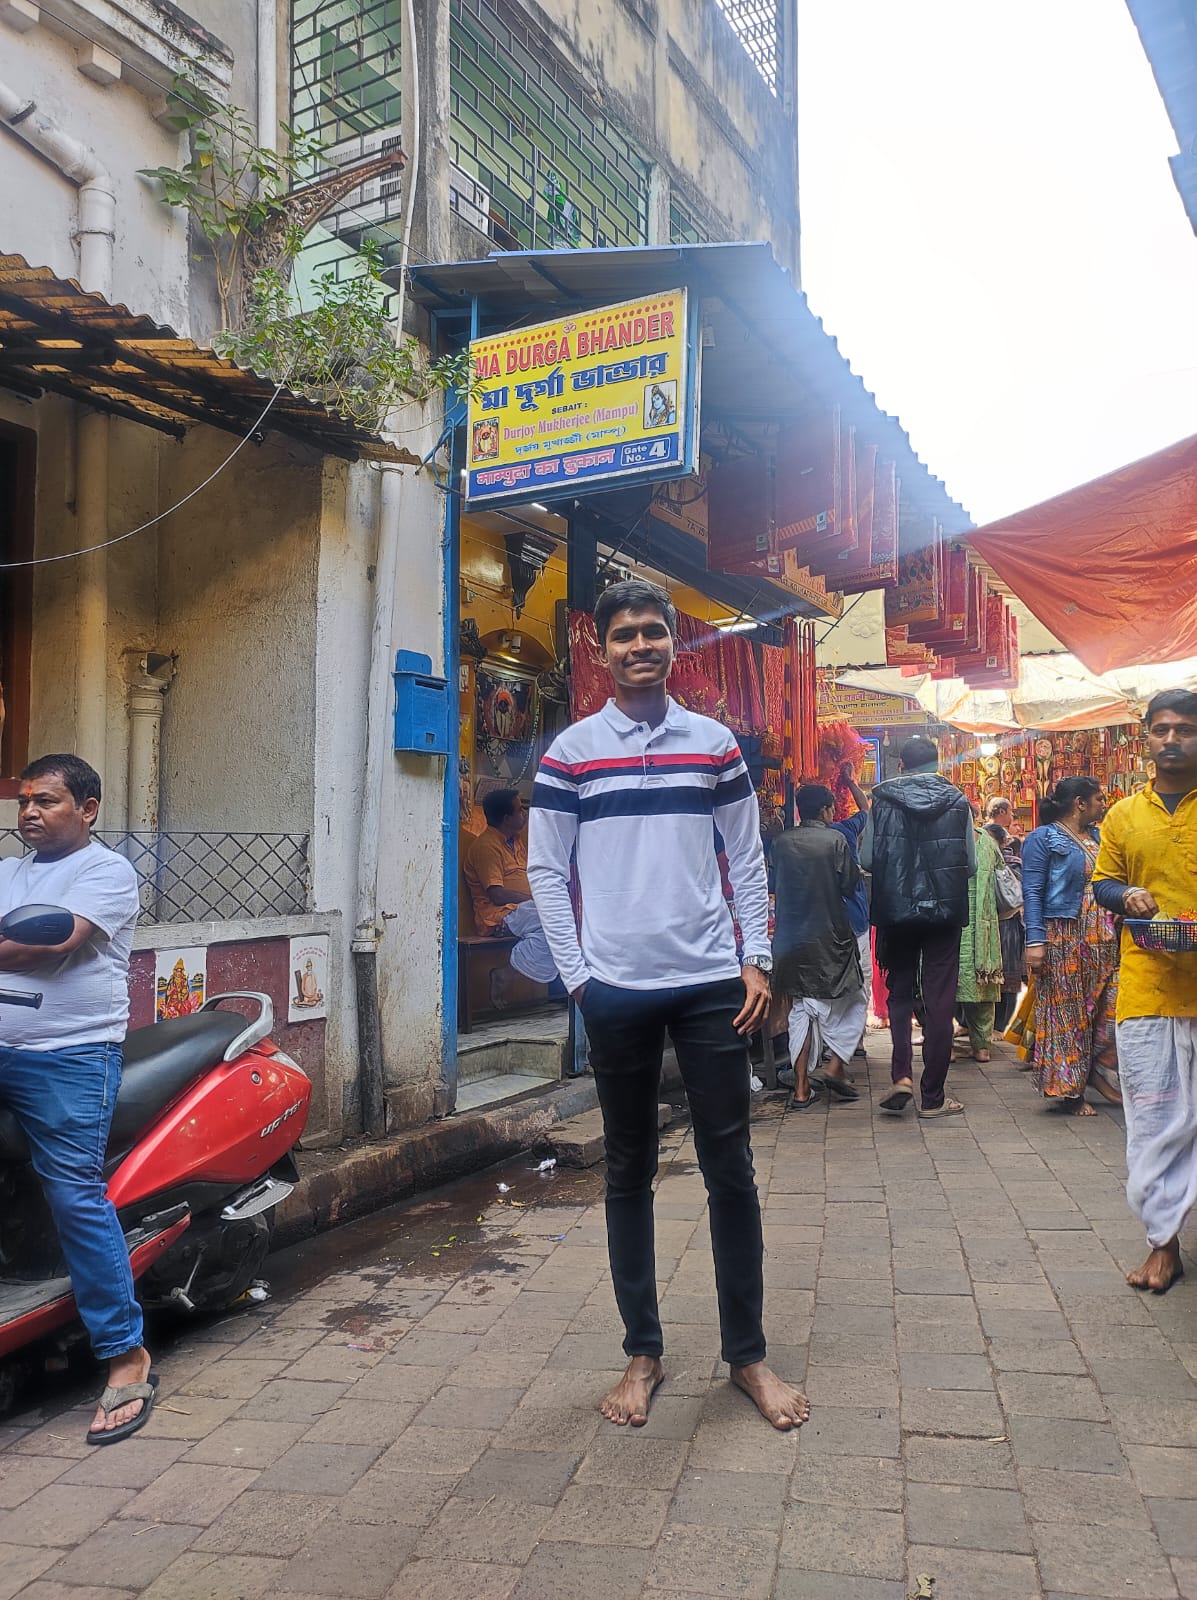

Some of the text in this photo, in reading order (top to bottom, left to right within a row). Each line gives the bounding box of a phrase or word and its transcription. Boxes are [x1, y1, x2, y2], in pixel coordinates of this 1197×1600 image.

[475, 311, 675, 379] MA DURGA BHANDER
[481, 386, 509, 411] মা
[503, 400, 639, 440] Durjoy Mukherjee (Mampu)
[534, 458, 560, 476] का
[563, 448, 616, 476] दुकान
[624, 444, 648, 455] Gate
[626, 440, 667, 464] No. 4
